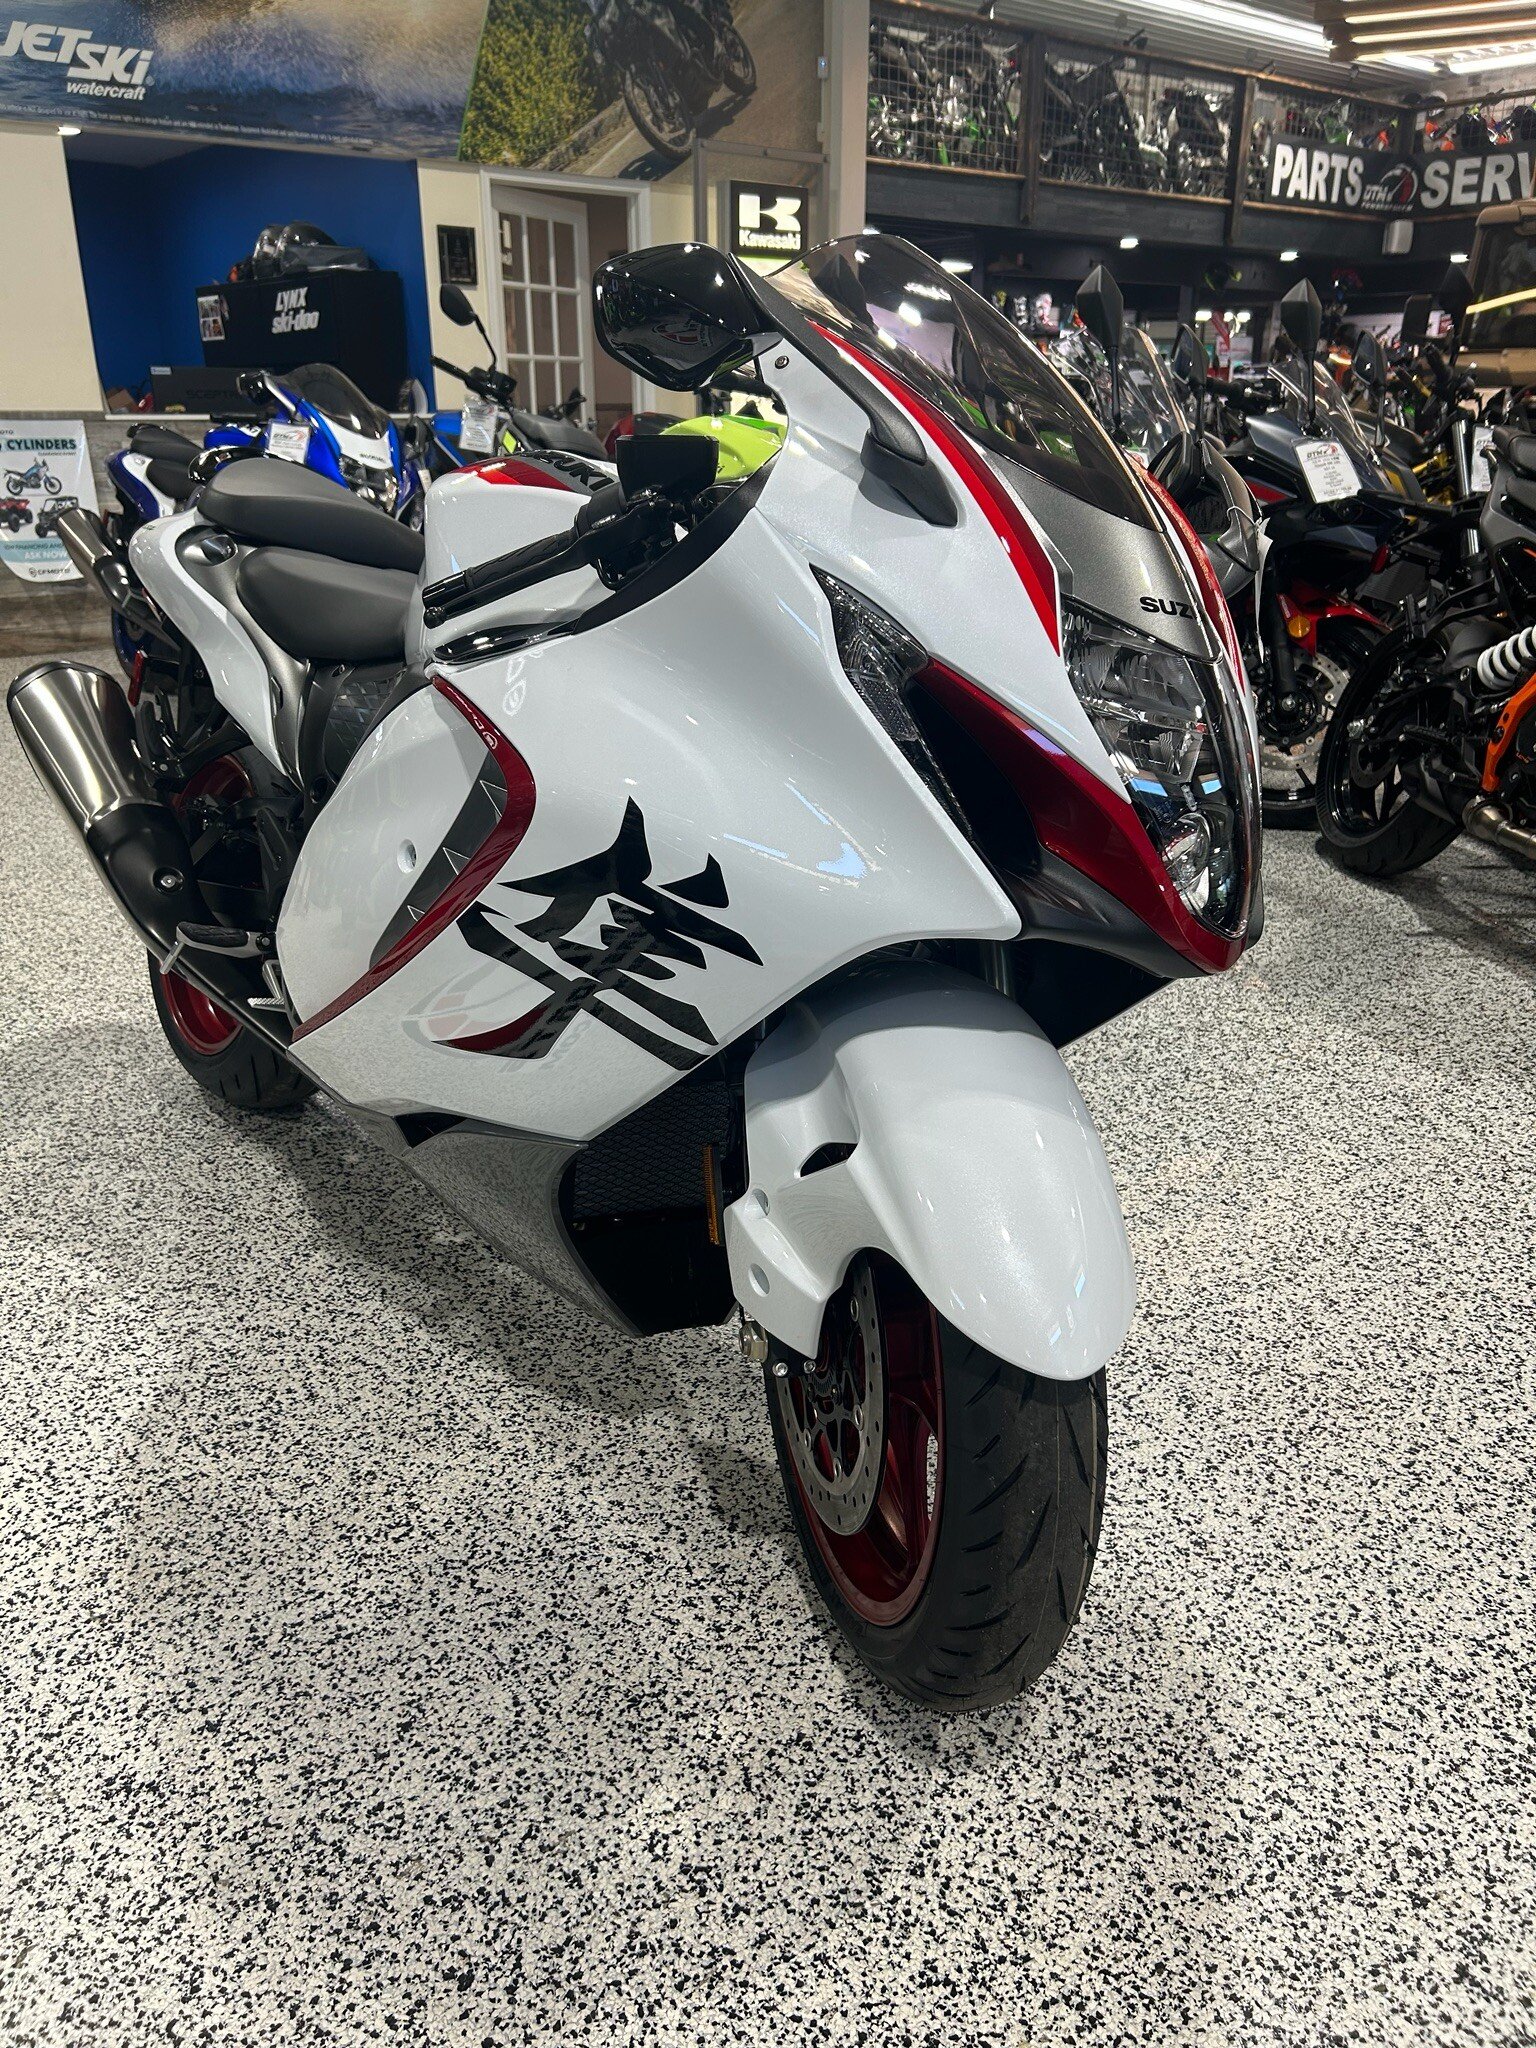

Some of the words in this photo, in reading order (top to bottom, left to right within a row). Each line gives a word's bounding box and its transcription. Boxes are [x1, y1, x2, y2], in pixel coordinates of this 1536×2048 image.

[67, 82, 146, 100] watercraft
[1271, 143, 1364, 206] PARTS
[739, 229, 801, 250] Kawasaki
[275, 287, 308, 312] LYNX
[271, 310, 320, 334] ski-doo
[7, 438, 77, 450] CYLINDERS
[1140, 596, 1194, 620] SUZ
